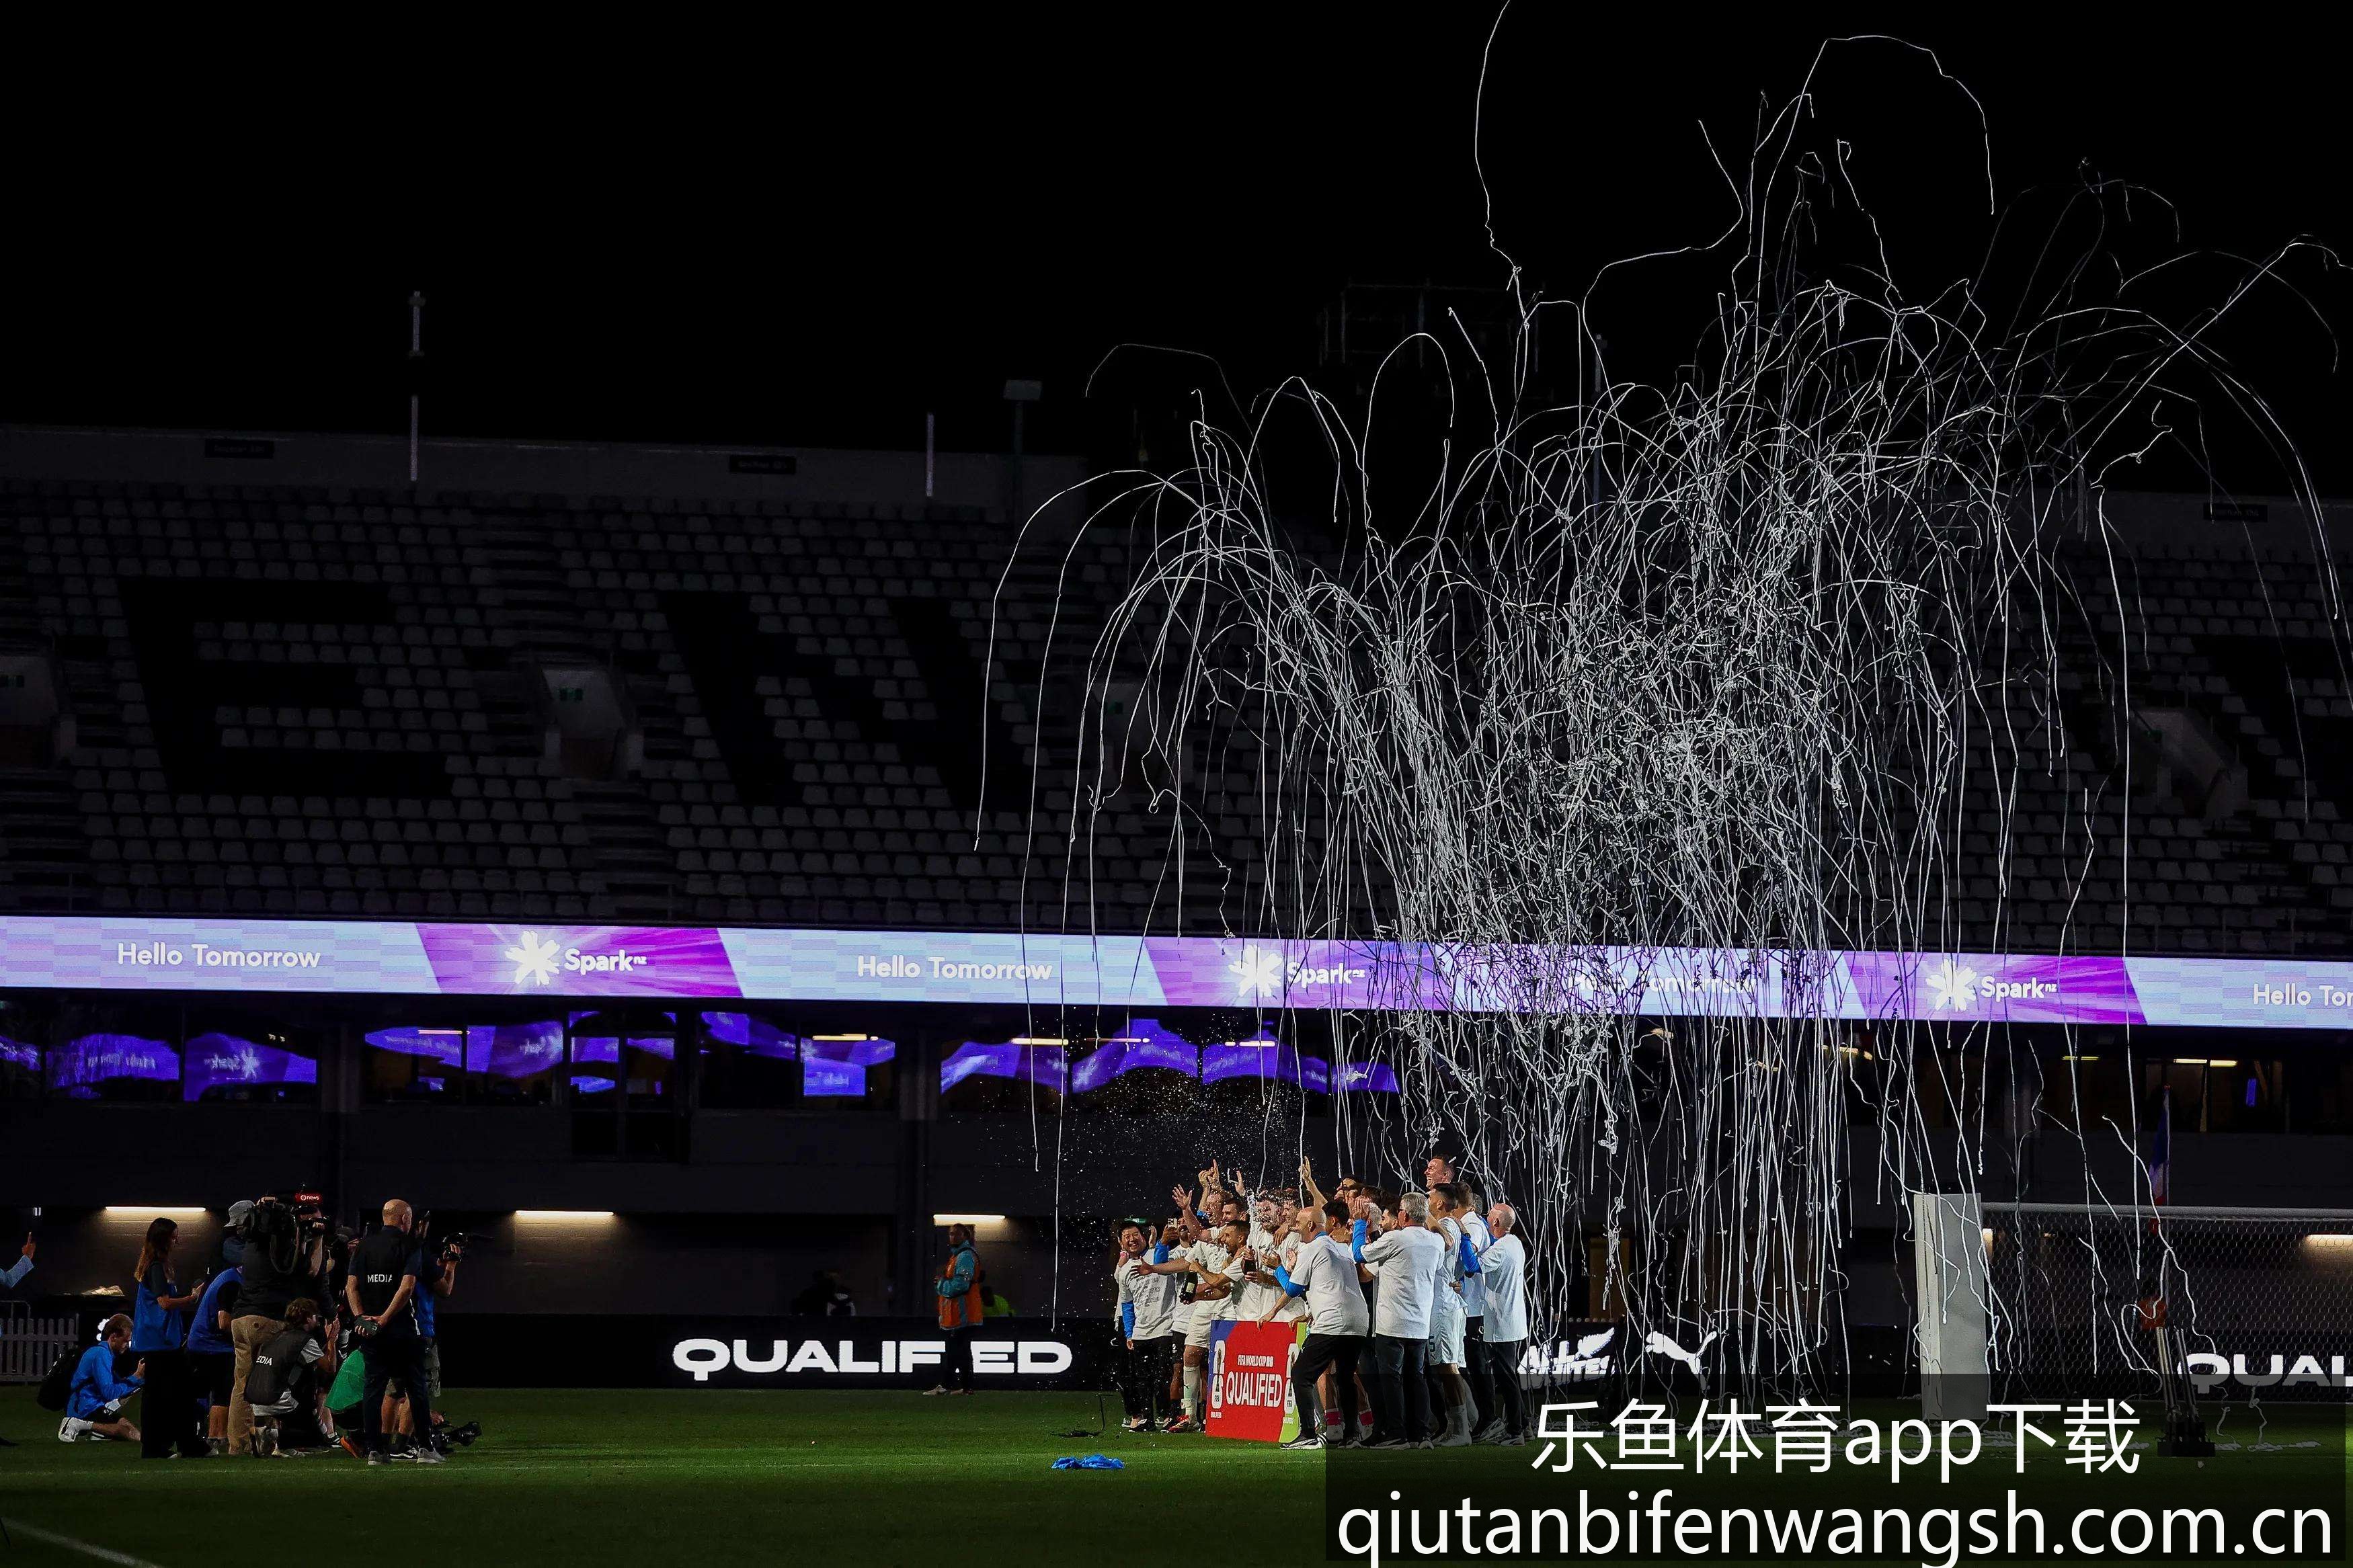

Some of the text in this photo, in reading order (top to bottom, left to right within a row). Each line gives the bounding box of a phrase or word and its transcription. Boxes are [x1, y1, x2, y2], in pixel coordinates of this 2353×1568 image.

[118, 942, 321, 968] Hello Tomorrow
[564, 948, 633, 975] Spark
[858, 954, 1053, 980] Hello Tomorrow
[1287, 962, 1352, 989] Spark
[1980, 975, 2044, 1002] Spark
[2254, 983, 2311, 1005] Hello
[367, 1274, 393, 1283] MEDIA
[672, 1338, 1073, 1381] QUALIFED
[1246, 1354, 1259, 1367] WORLD
[1226, 1371, 1283, 1408] QUALIFIED
